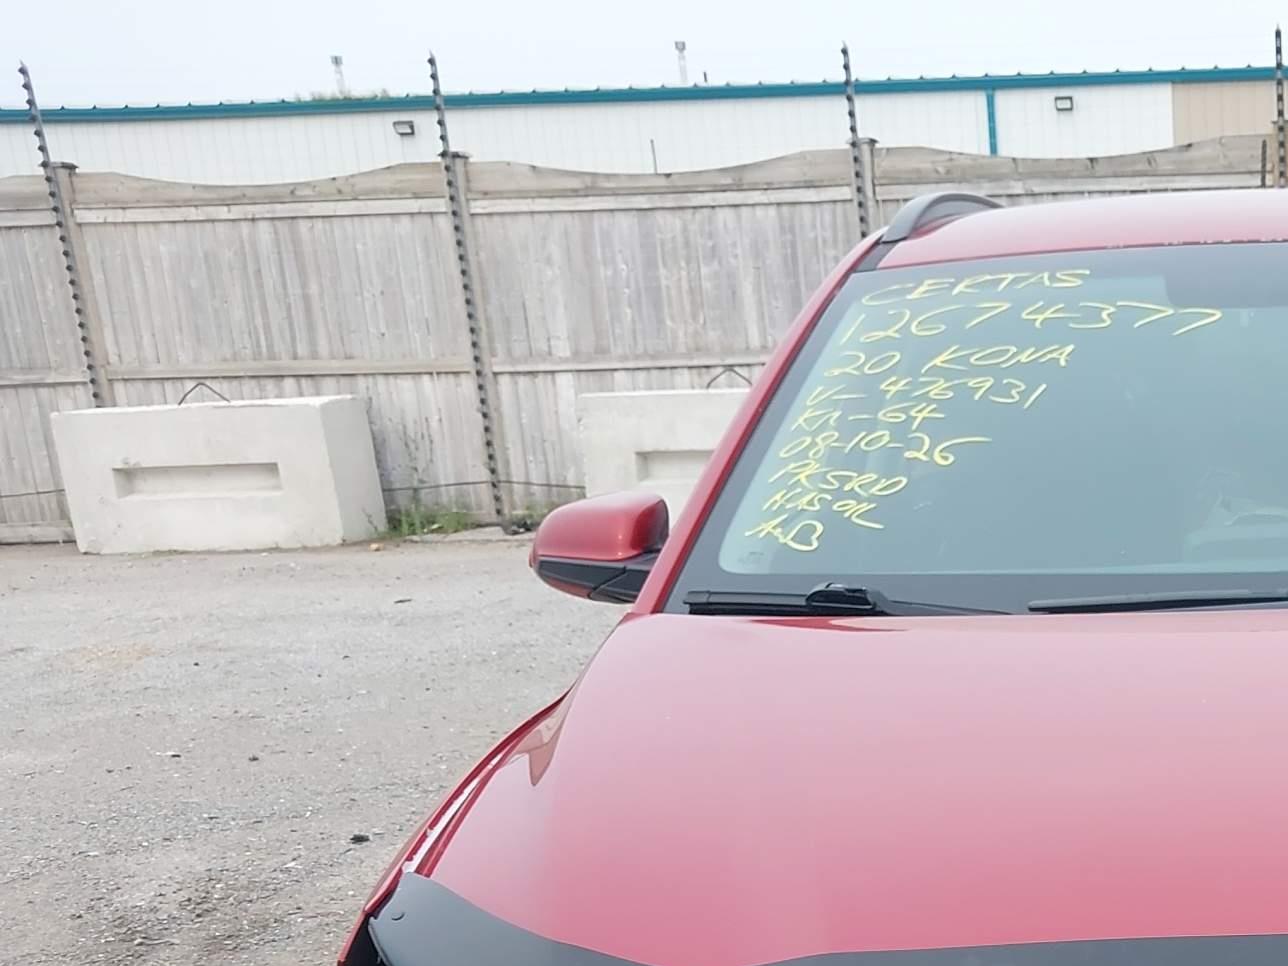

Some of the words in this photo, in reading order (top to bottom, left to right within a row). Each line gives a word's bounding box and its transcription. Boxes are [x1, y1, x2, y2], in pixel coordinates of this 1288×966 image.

[862, 269, 1091, 306] CERTAS
[840, 299, 1224, 346] 12674377
[824, 351, 901, 377] 20
[921, 343, 1076, 374] KONA
[778, 429, 993, 467] 08-10-26
